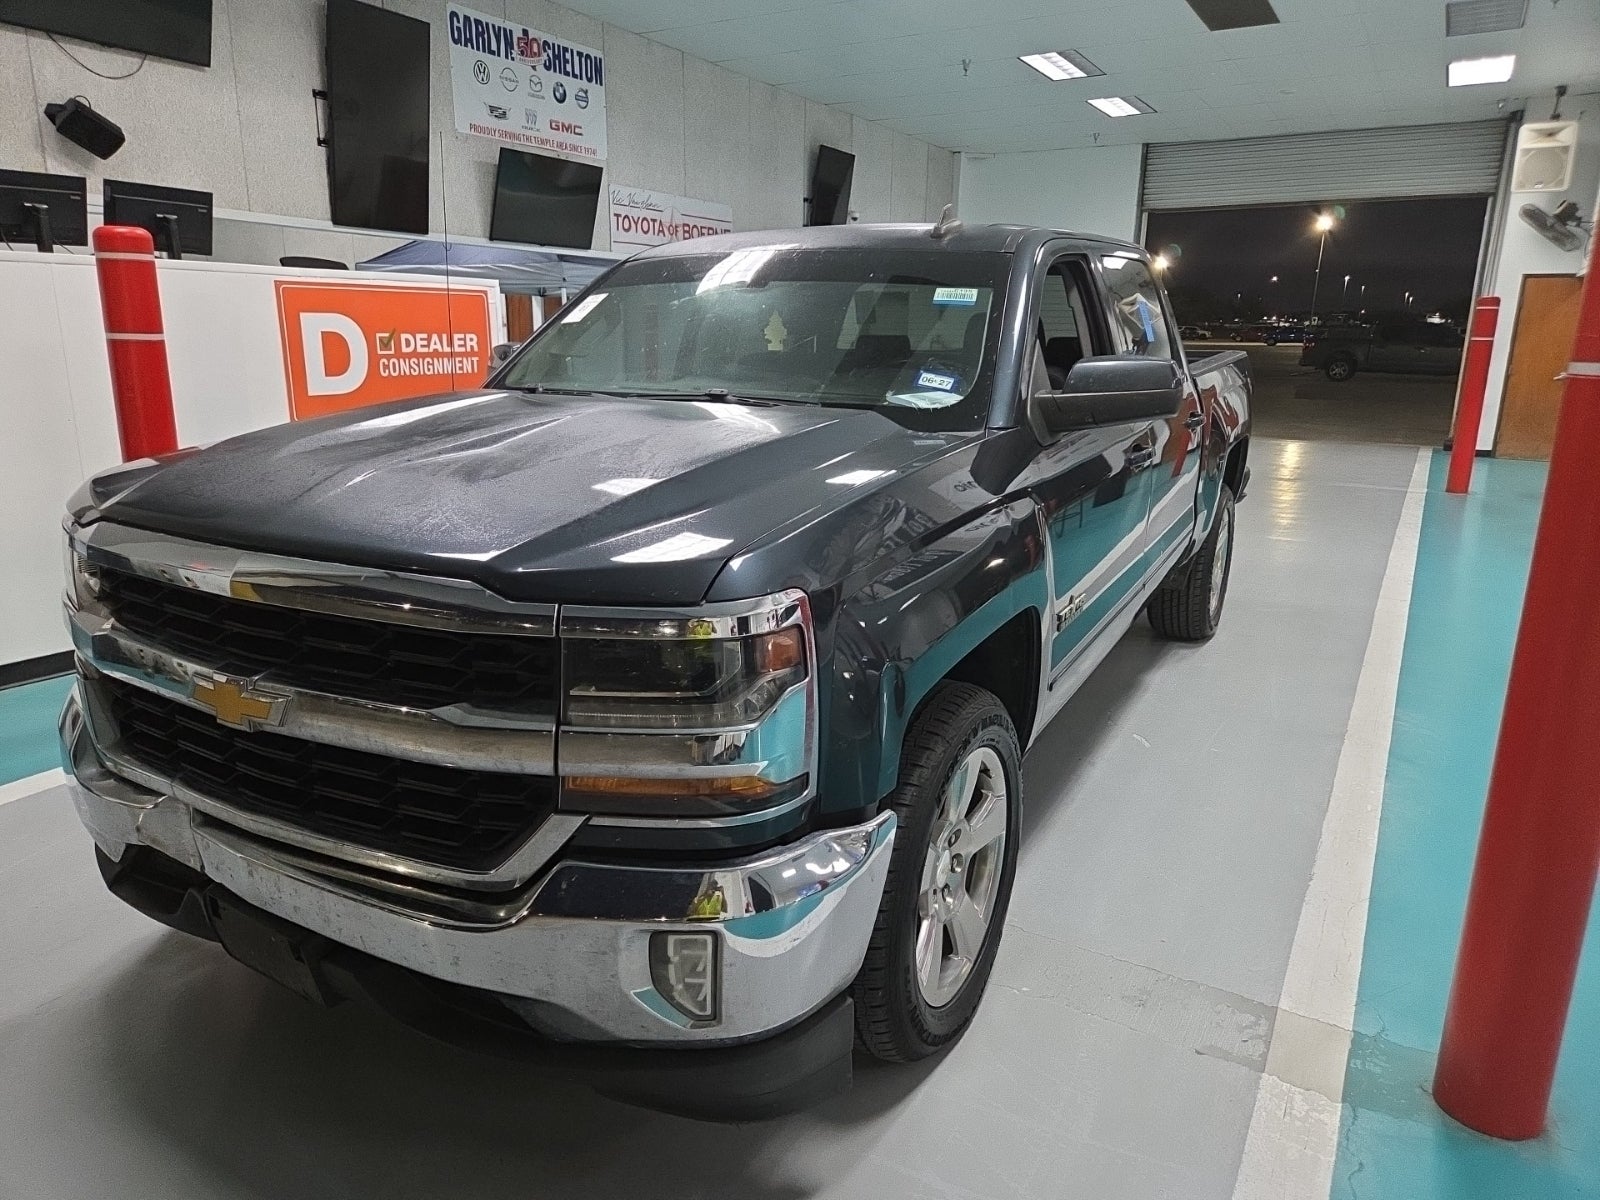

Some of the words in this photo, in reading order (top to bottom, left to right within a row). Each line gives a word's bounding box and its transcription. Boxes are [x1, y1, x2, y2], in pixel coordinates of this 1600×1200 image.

[449, 11, 515, 61] GARLYN
[542, 39, 603, 86] SHELTON
[469, 122, 497, 138] PROUDLY
[498, 128, 522, 143] SERVING
[522, 133, 534, 145] THE
[534, 136, 556, 149] TEMPLE
[556, 141, 569, 152] AREA
[568, 143, 584, 154] SINCE
[549, 119, 583, 136] GMC
[613, 212, 666, 238] TOYOTA
[667, 224, 681, 239] OF
[299, 311, 369, 397] D
[400, 333, 479, 353] DEALER
[379, 356, 479, 377] CONSIGNMENT
